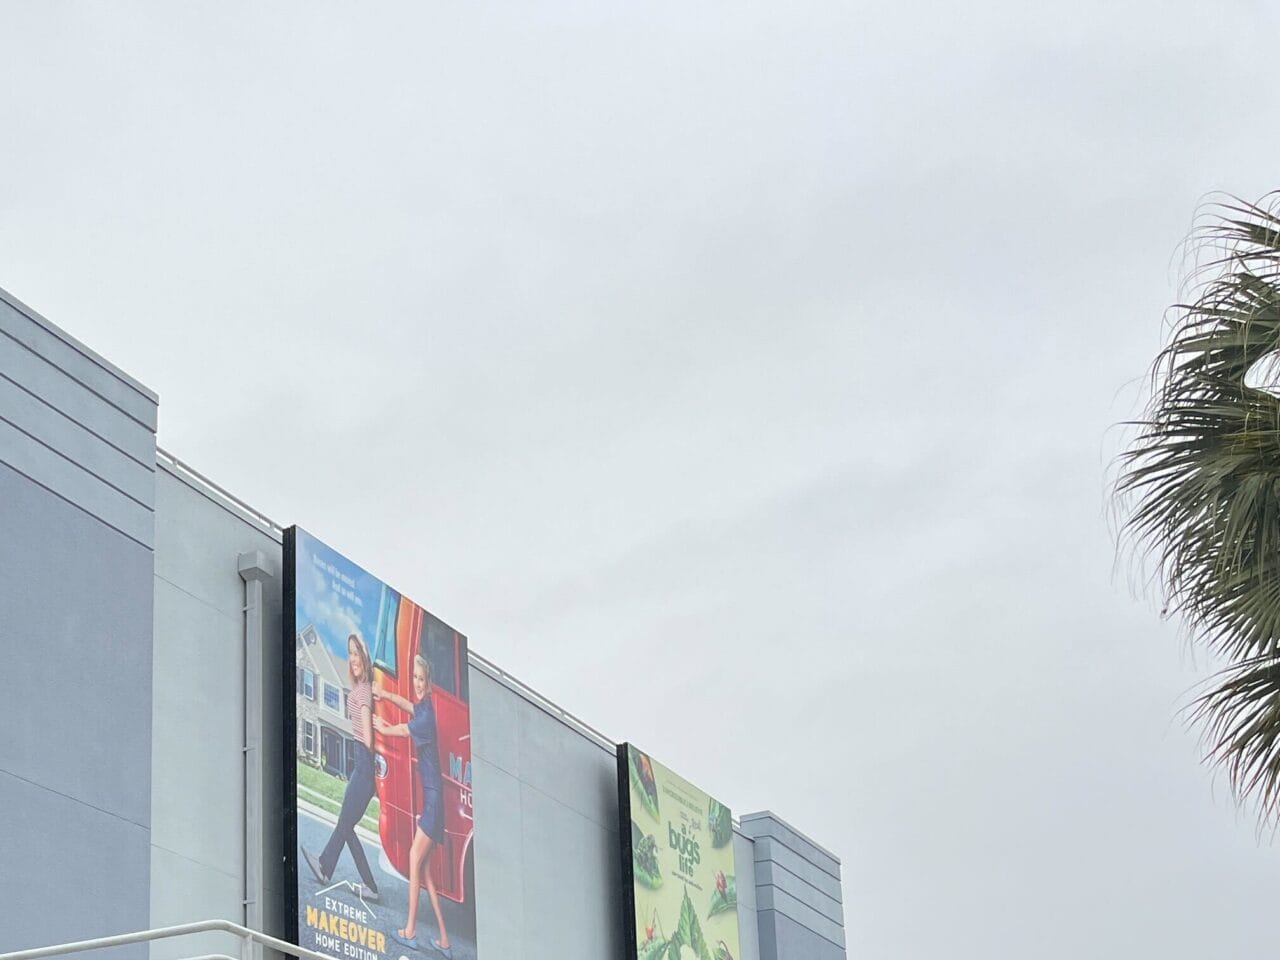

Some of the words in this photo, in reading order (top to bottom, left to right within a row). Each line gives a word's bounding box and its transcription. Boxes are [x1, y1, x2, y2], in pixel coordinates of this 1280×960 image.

[679, 854, 694, 877] life
[325, 896, 368, 924] EXTREME
[306, 904, 386, 954] MAKEOVER
[315, 932, 341, 953] HOME
